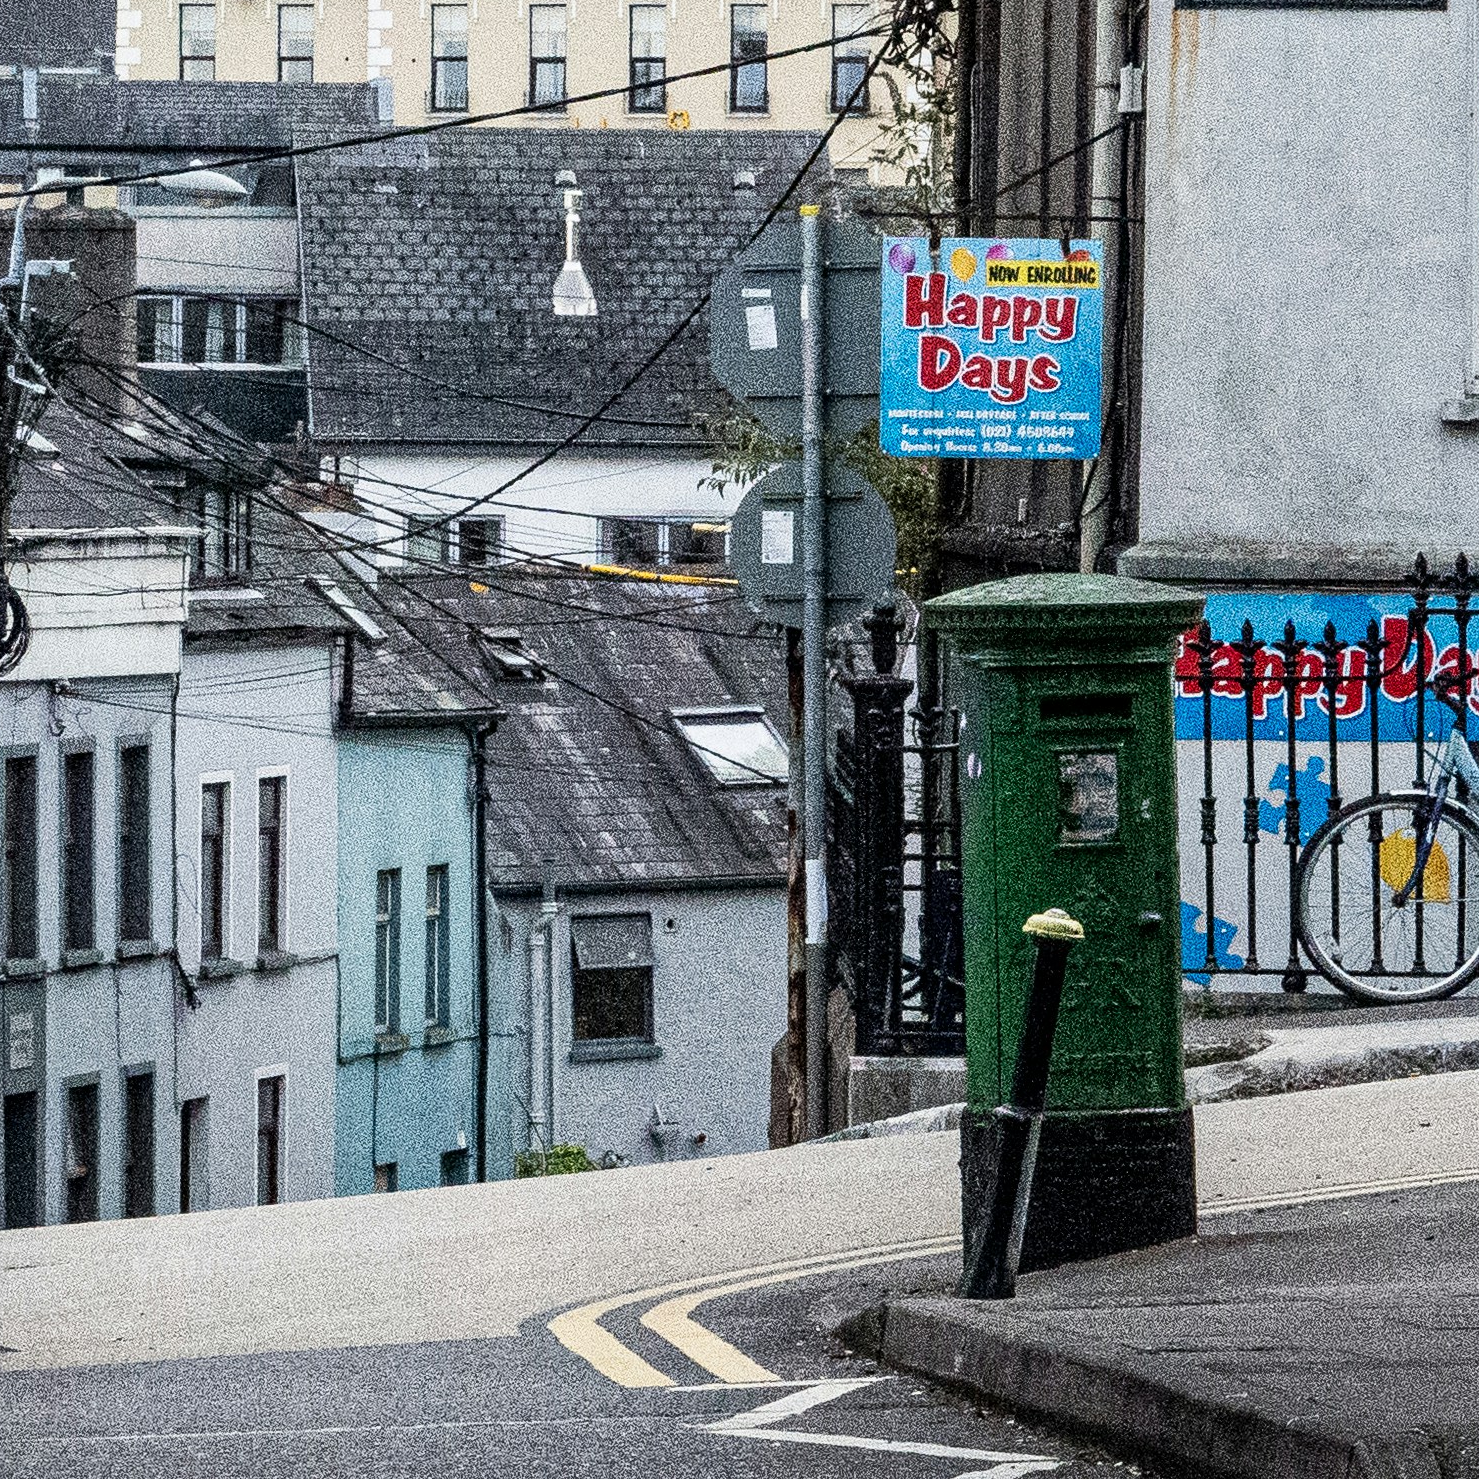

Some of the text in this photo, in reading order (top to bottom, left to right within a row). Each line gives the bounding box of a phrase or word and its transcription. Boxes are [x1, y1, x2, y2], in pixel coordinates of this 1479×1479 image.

[904, 272, 1078, 342] Happy
[988, 265, 1097, 284] NOW ENROLLING
[919, 334, 1060, 404] Days
